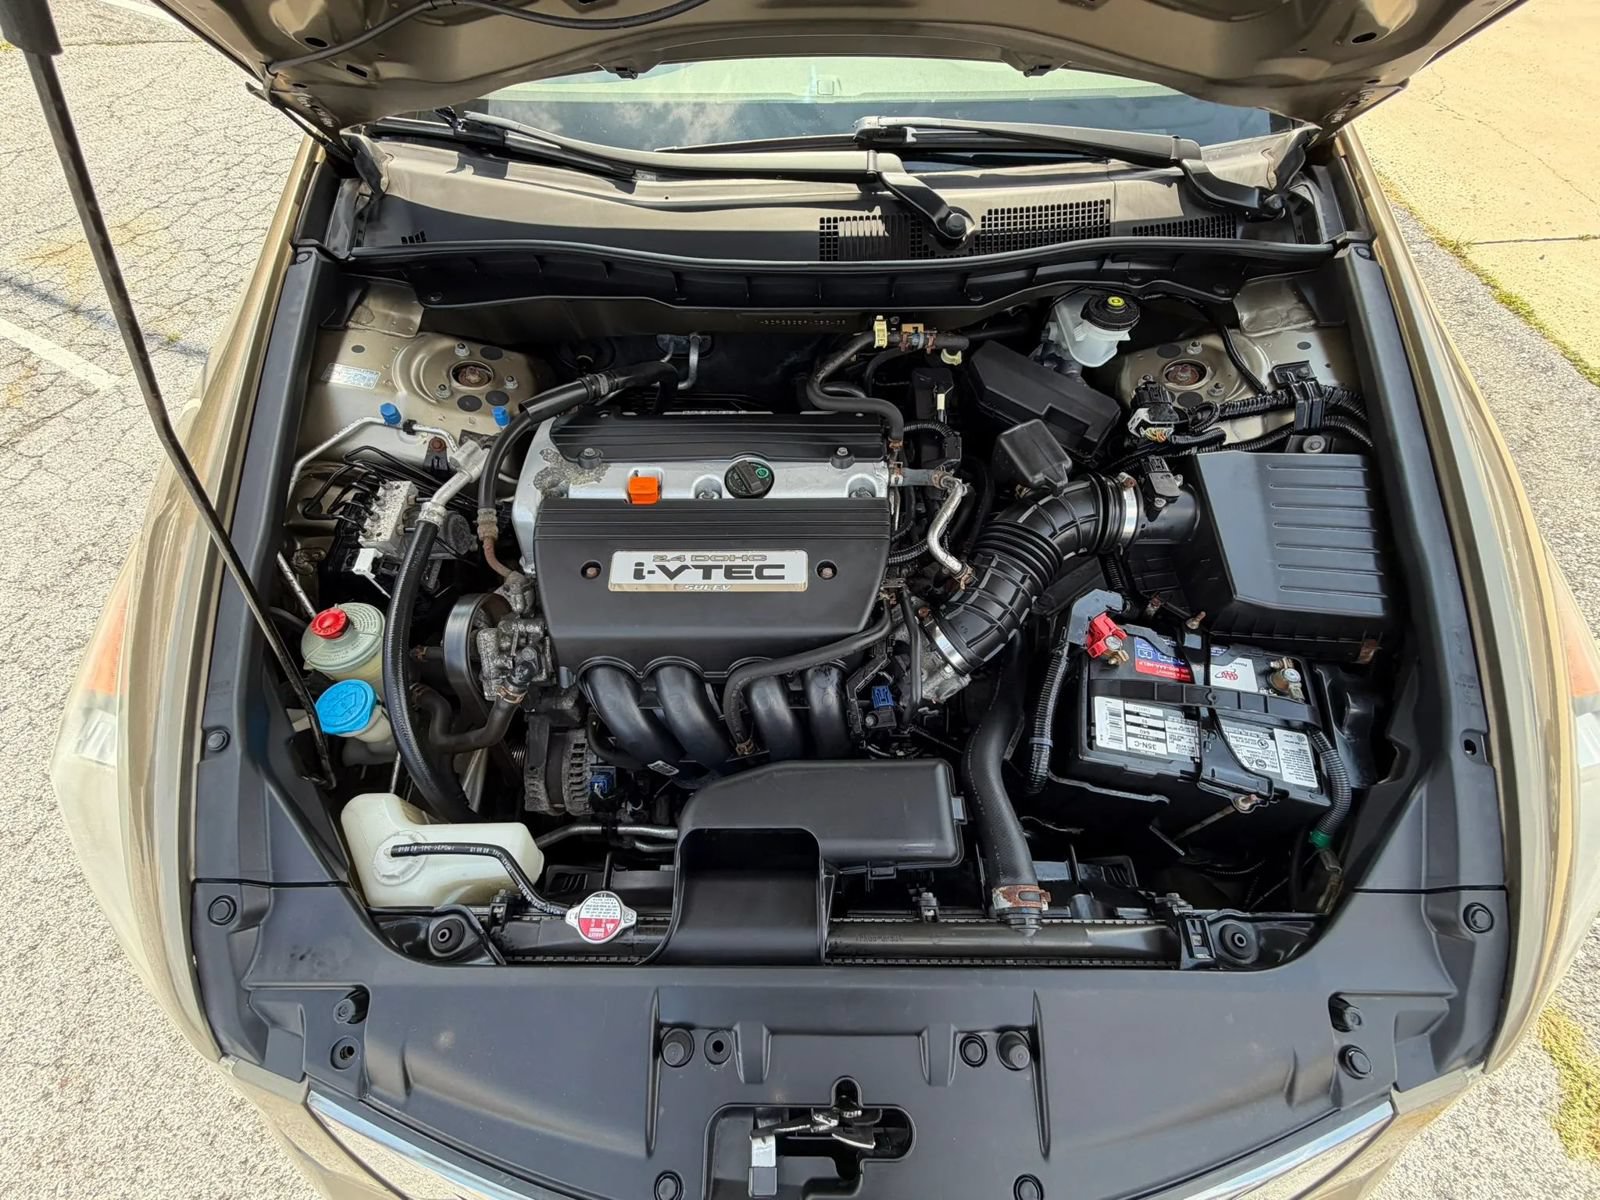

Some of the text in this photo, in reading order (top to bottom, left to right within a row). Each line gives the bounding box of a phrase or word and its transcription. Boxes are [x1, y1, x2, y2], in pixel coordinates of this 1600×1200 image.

[652, 554, 767, 562] 2.4 DOHC
[633, 562, 785, 581] i-VTEC
[1134, 740, 1157, 751] 35N-C
